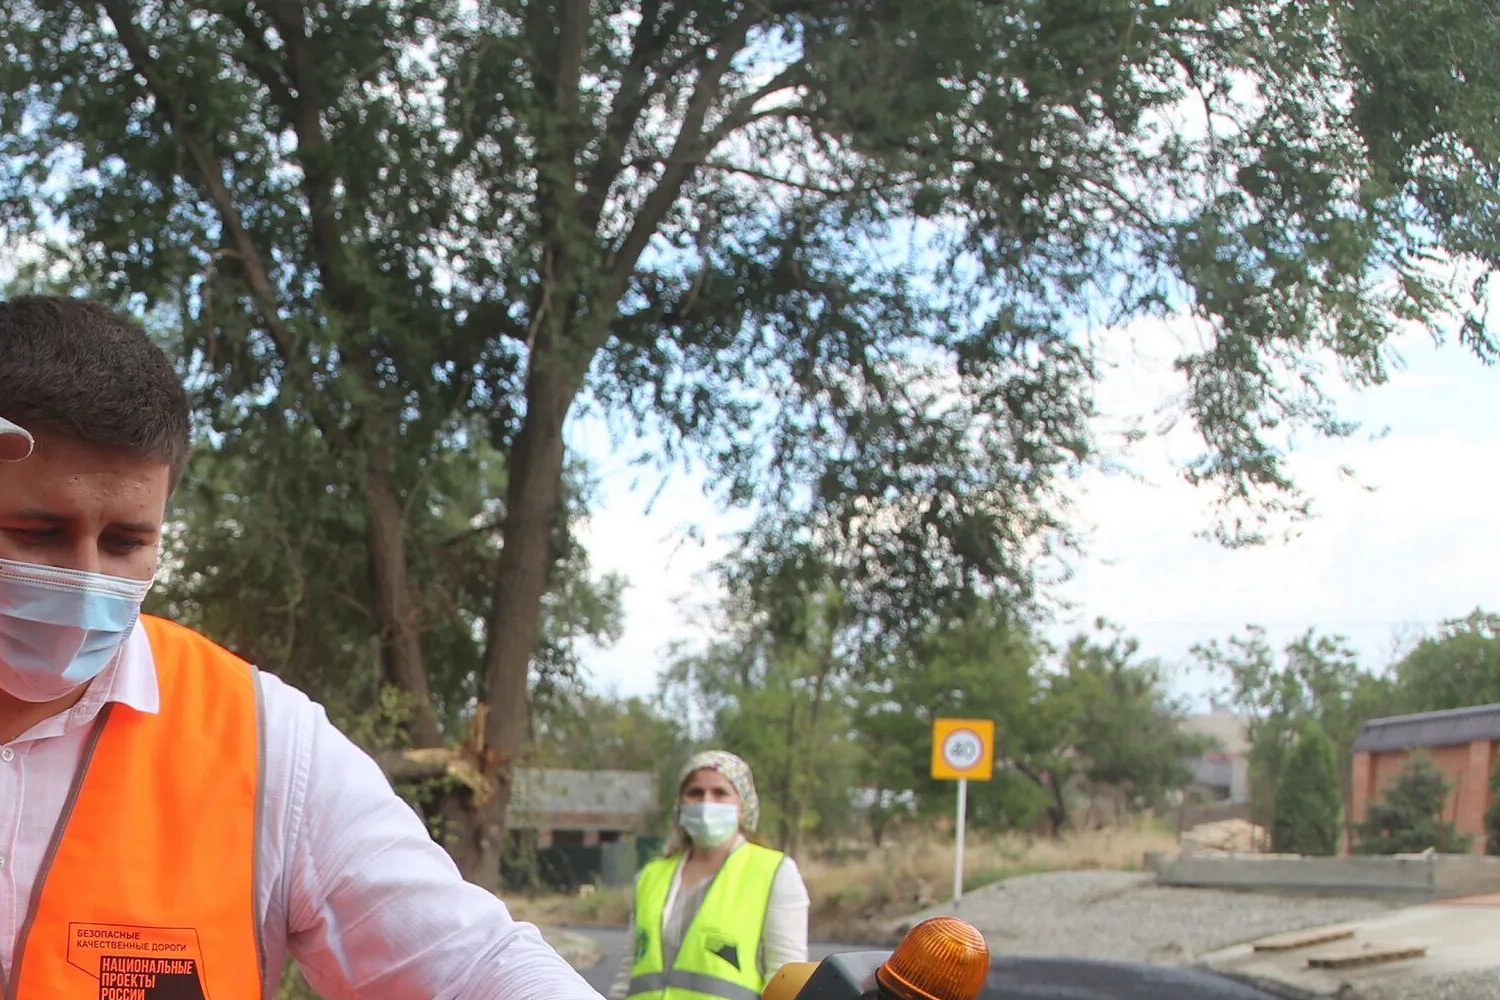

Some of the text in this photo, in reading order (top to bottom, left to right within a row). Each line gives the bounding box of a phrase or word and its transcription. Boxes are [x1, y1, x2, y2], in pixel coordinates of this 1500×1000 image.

[951, 741, 976, 760] 40
[77, 929, 140, 940] БЕЗОПАСНЫЕ
[76, 940, 187, 952] КАЧЕСТВЕННЫЕ ДОРОГИ
[102, 958, 194, 975] НАЦИОНАЛЬНЫЕ
[101, 973, 156, 988] ПРОЕКТЫ
